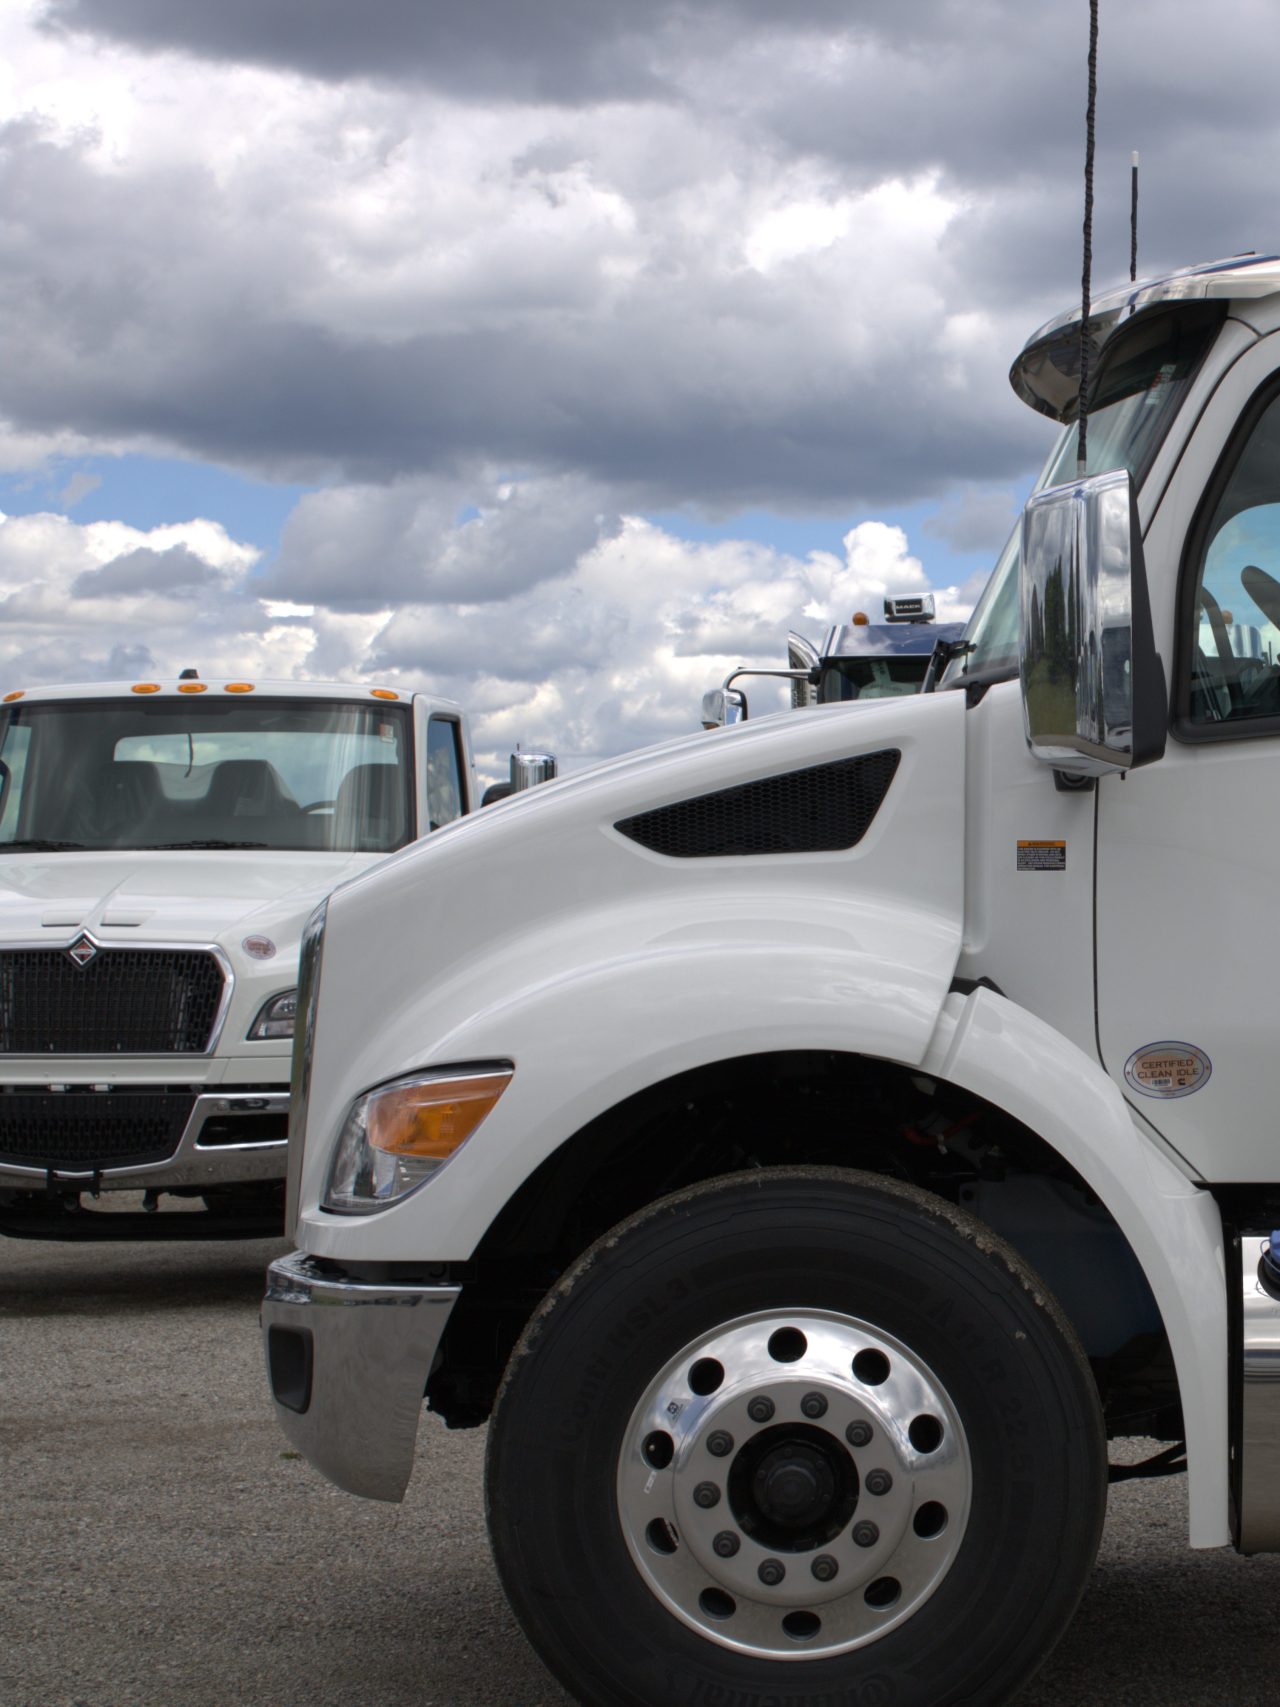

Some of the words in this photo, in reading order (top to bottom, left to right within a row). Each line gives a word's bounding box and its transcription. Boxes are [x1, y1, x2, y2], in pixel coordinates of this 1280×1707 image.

[1141, 1059, 1194, 1069] CERTIFIED
[1137, 1070, 1172, 1079] CLEAN
[1177, 1068, 1199, 1077] IDLE
